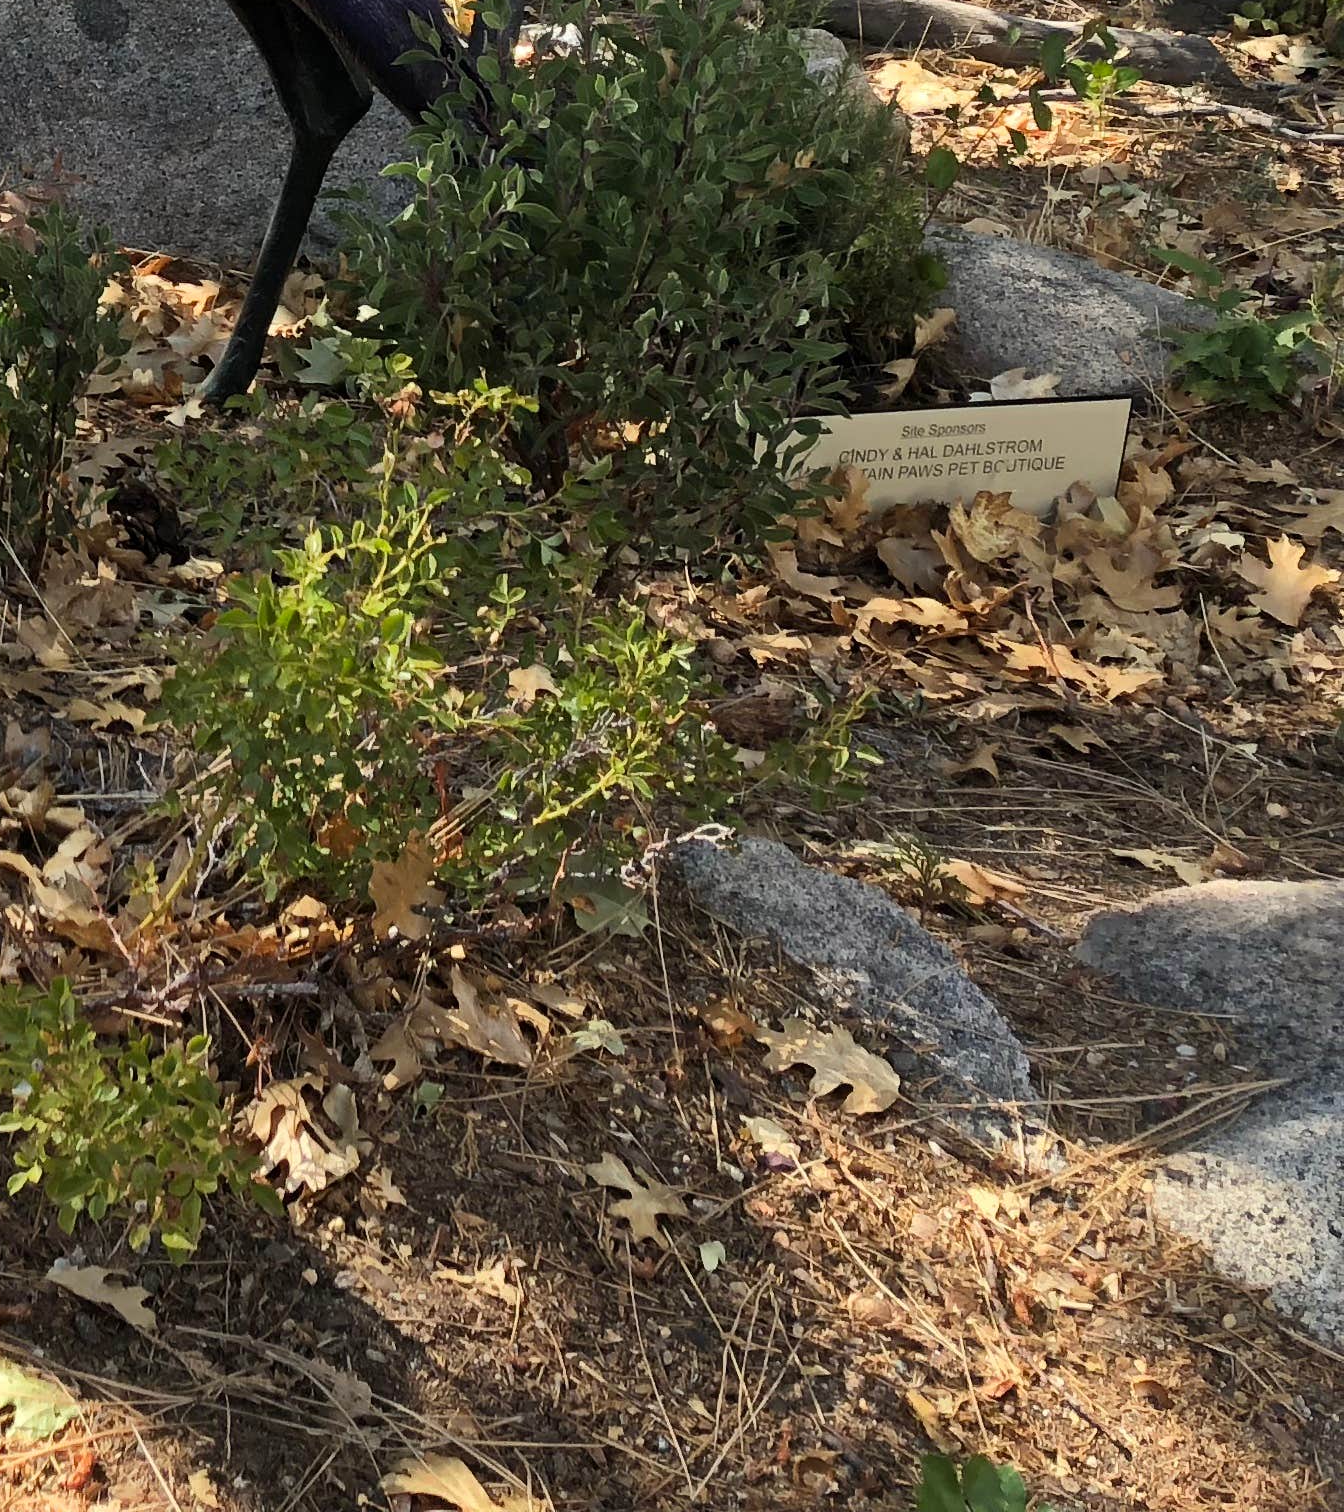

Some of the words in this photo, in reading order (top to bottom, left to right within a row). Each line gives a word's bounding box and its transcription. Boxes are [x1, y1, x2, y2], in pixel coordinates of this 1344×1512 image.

[902, 425, 925, 437] Site
[929, 423, 986, 438] Sponsors
[839, 448, 889, 464] CINDY
[892, 448, 902, 461] &
[908, 446, 938, 460] HAL
[943, 438, 1043, 458] DAHLSTROM
[898, 463, 943, 479] PAWS
[948, 461, 980, 476] PET
